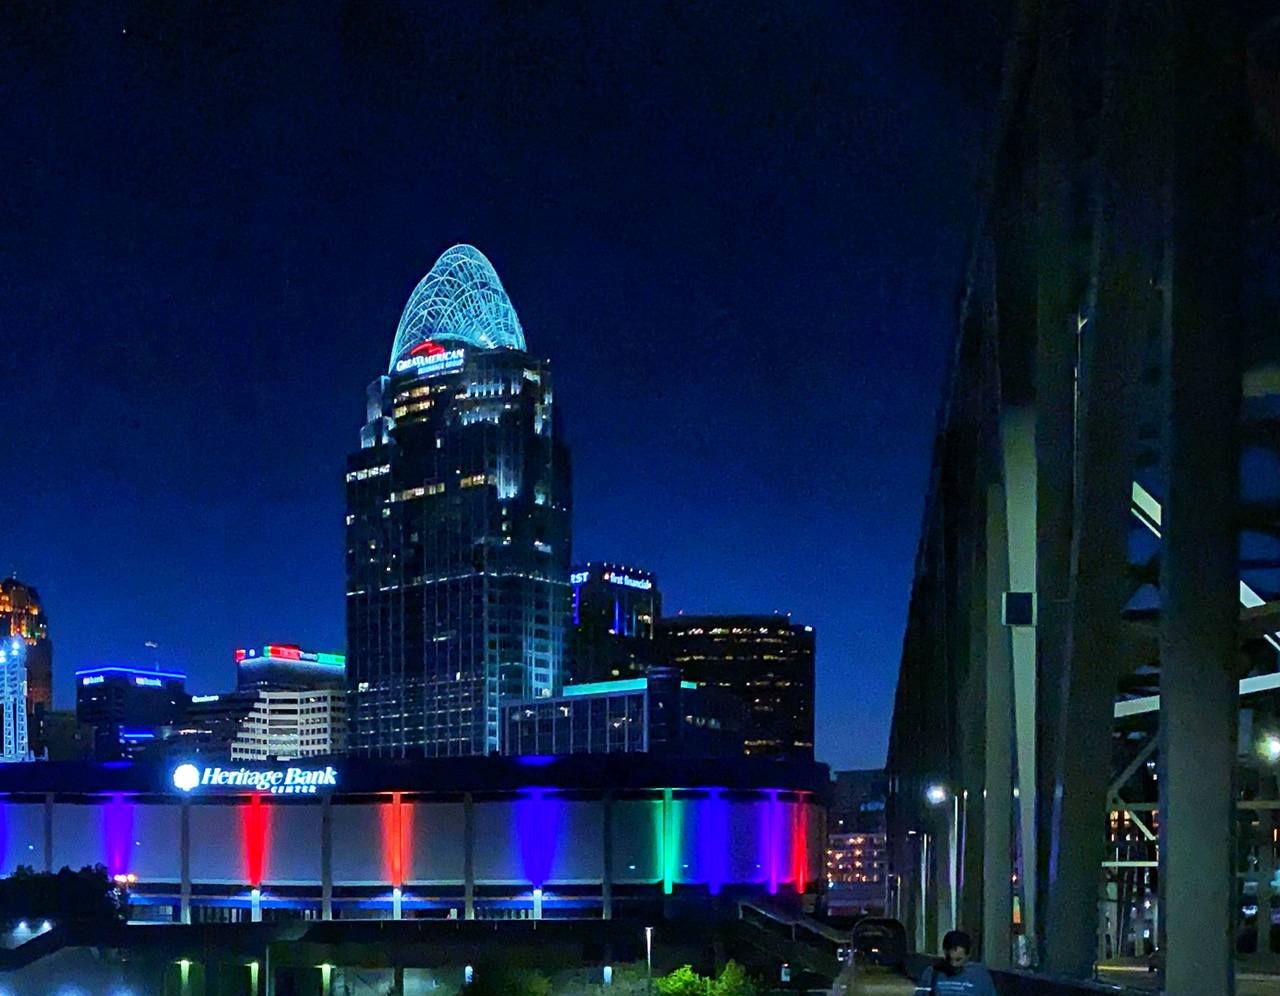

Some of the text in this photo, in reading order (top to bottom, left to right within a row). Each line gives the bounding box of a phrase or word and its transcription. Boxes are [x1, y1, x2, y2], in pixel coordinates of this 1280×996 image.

[624, 575, 649, 590] financial
[202, 766, 338, 790] Heritage Bank
[270, 785, 317, 794] CENTER
